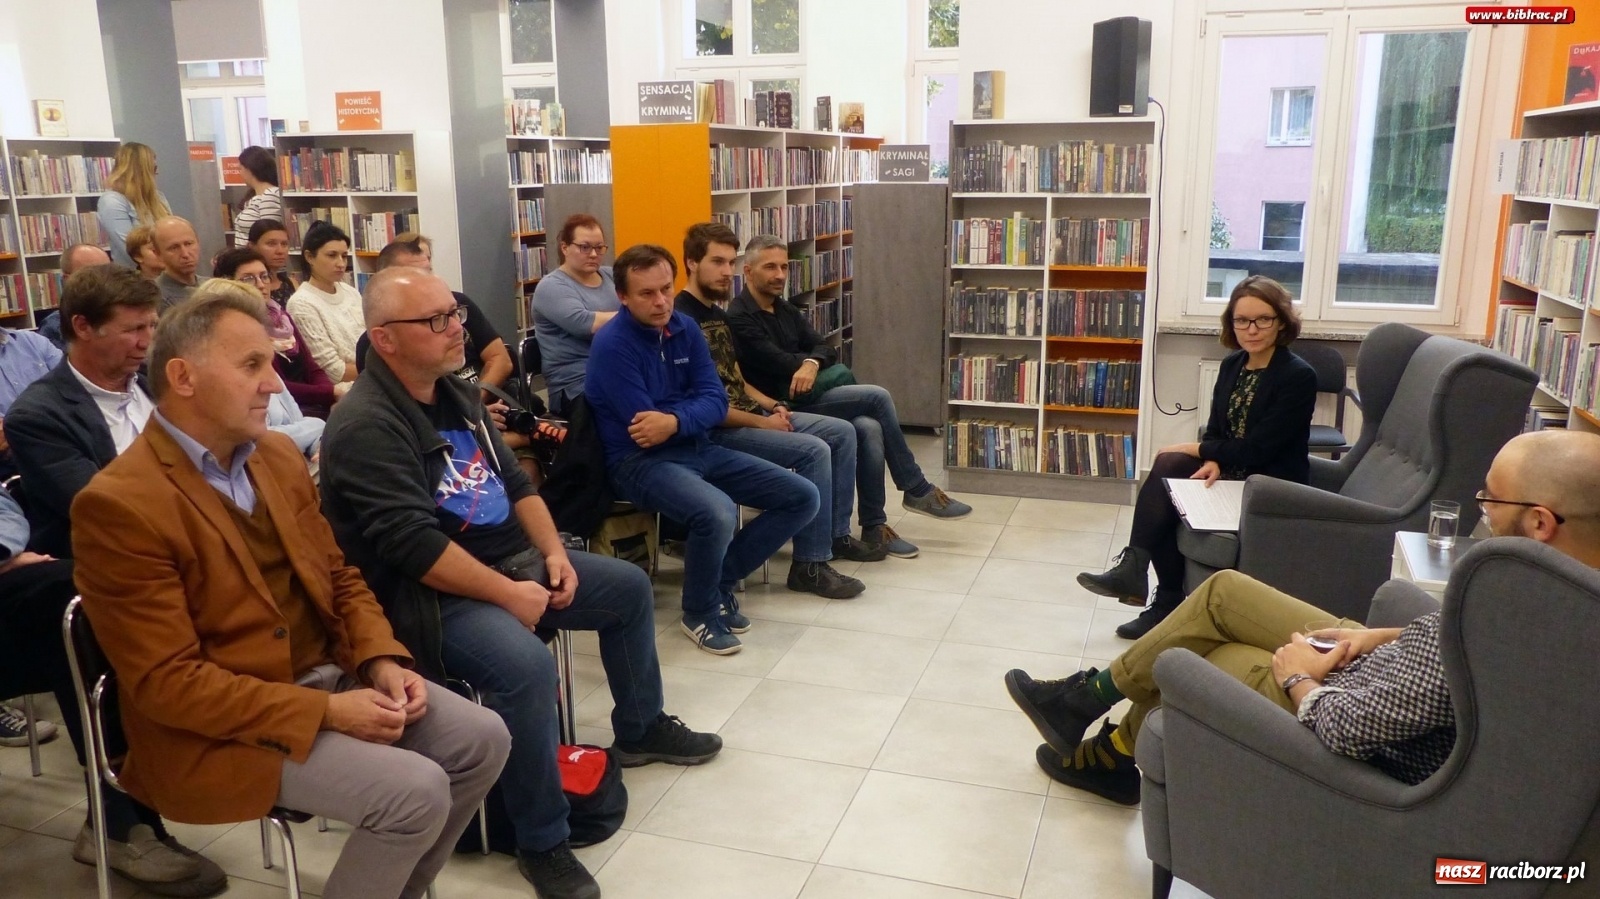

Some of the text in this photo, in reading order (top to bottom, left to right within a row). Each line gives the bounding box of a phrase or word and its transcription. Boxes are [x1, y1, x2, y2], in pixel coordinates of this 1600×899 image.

[640, 84, 692, 95] SENSACJA
[344, 96, 372, 105] POWIEŚĆ
[641, 105, 693, 116] KRYMINAŁ
[880, 151, 929, 160] KRYMINAŁ
[892, 168, 915, 177] SAGI
